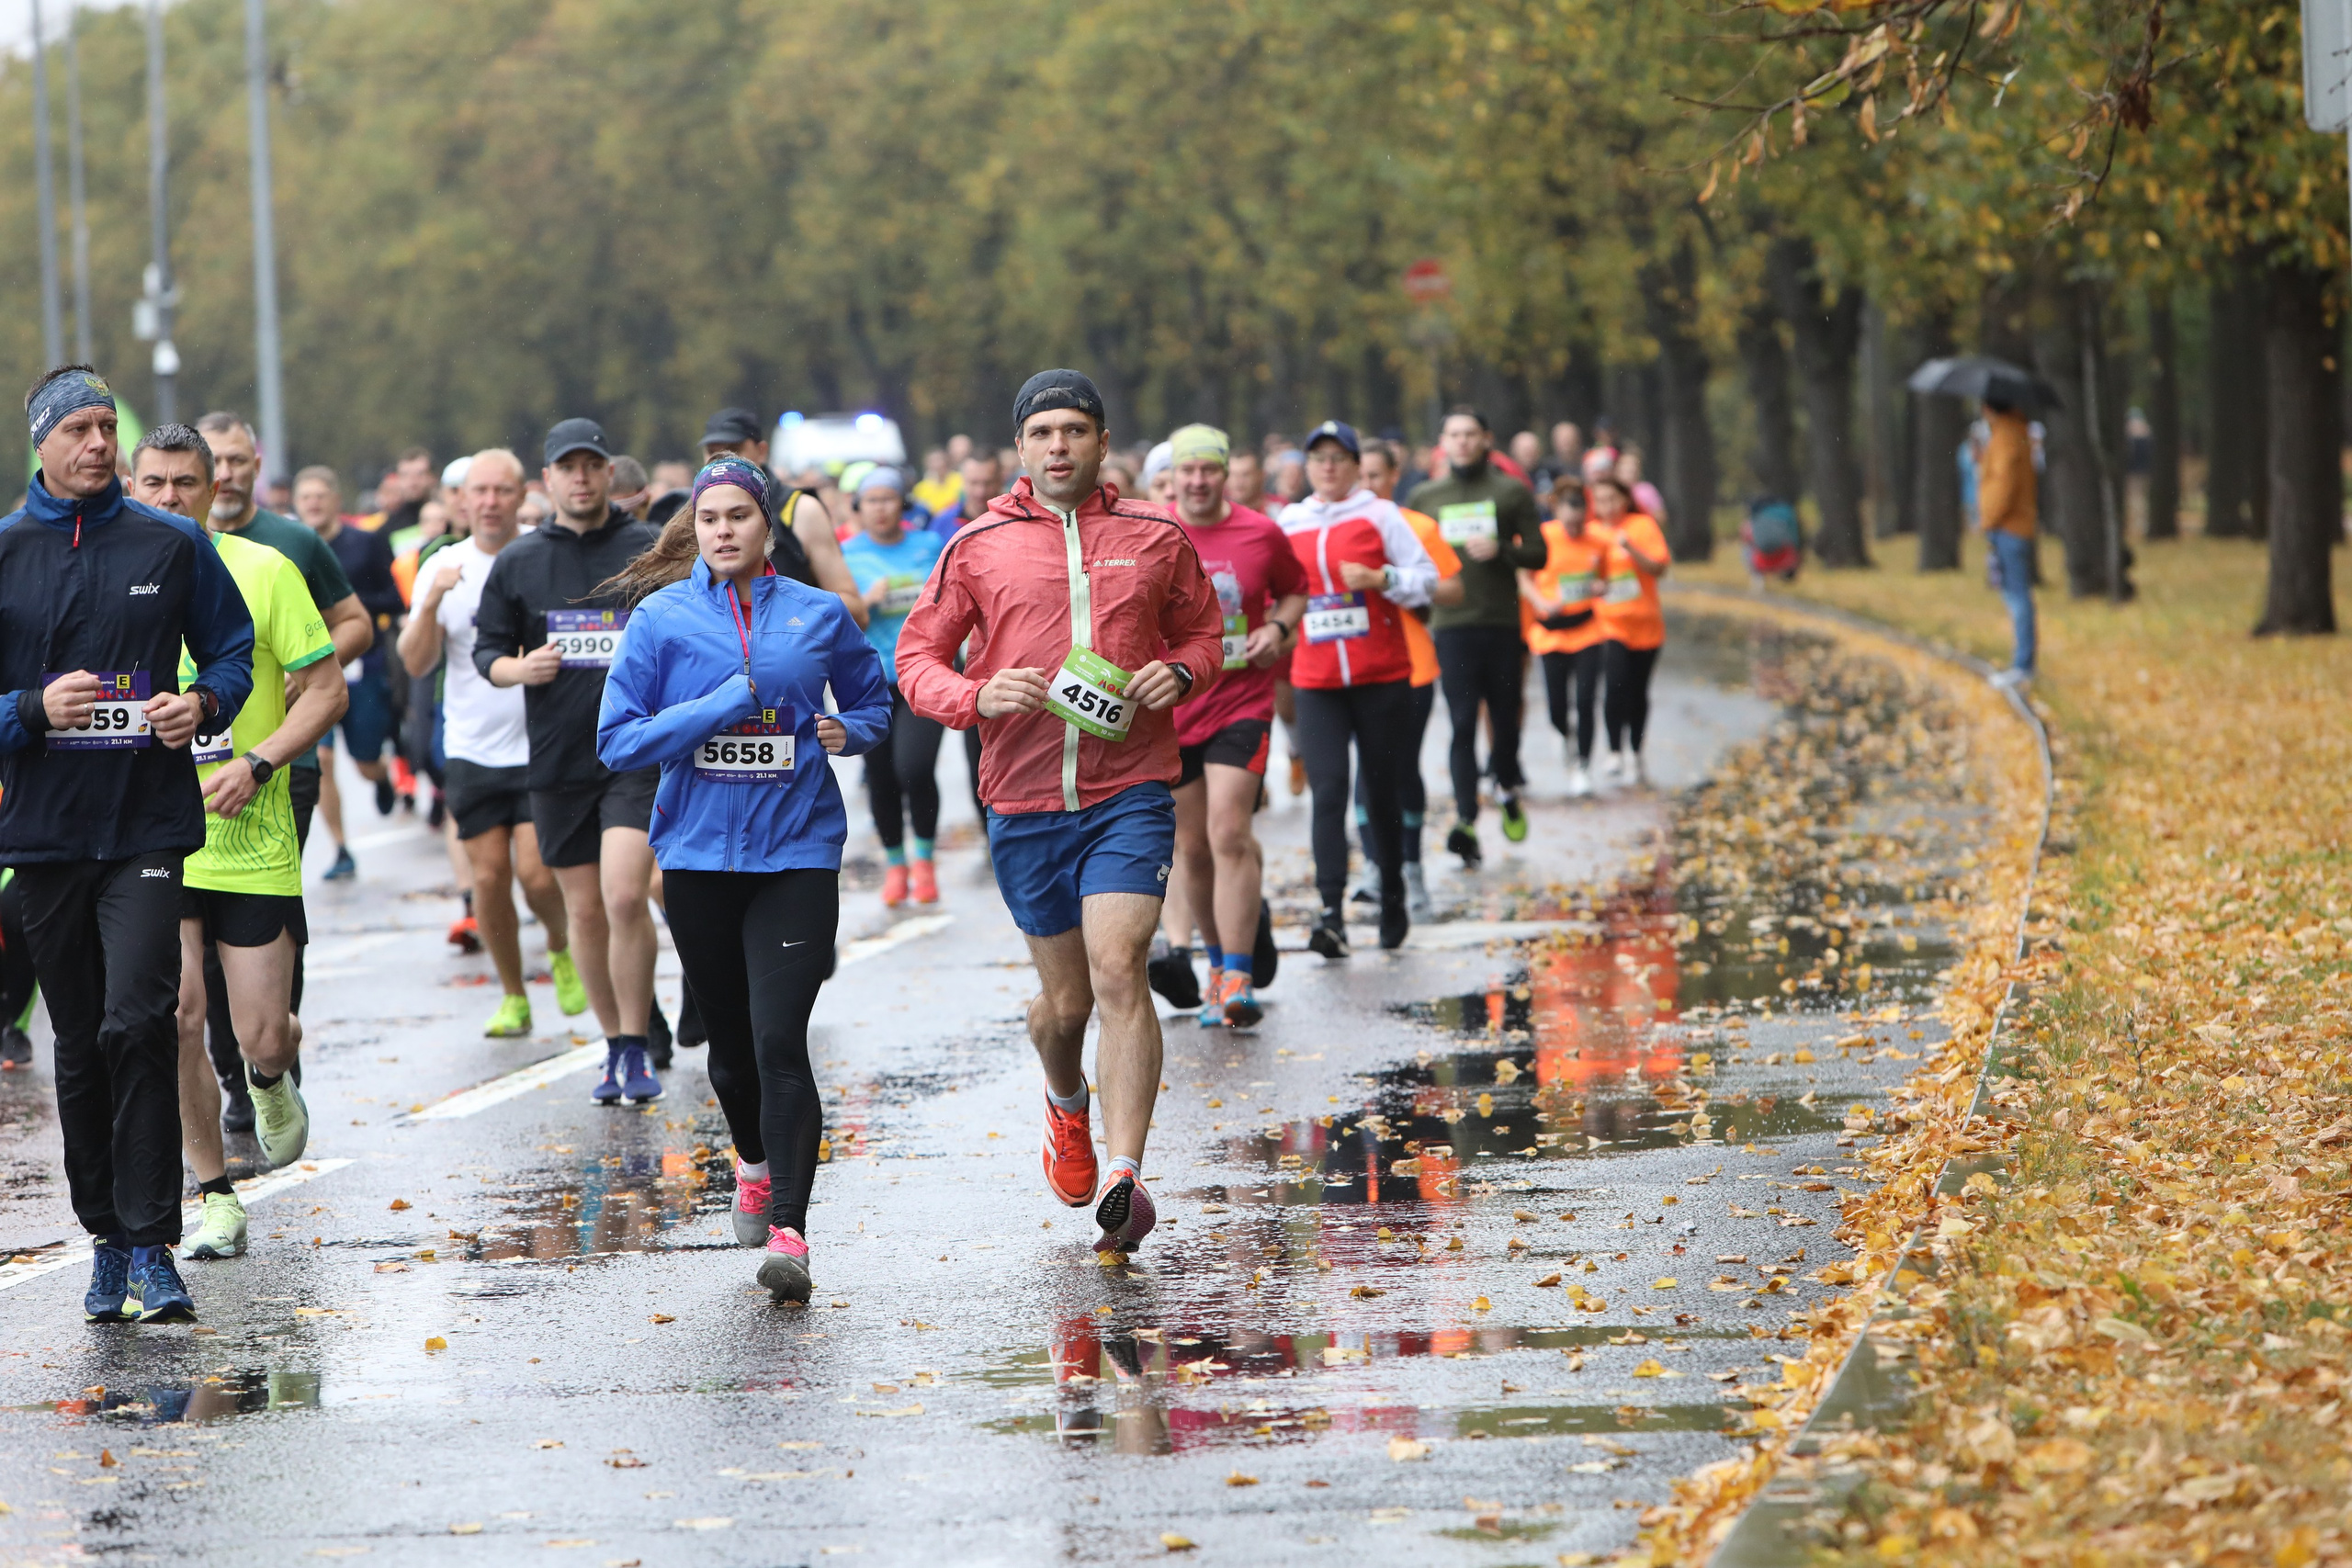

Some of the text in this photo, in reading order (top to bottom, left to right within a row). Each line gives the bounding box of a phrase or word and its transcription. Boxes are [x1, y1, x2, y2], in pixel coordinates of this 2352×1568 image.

[1104, 558, 1136, 567] TERREX
[556, 637, 614, 654] 5990
[1061, 683, 1124, 724] 4516
[703, 741, 775, 764] 5658
